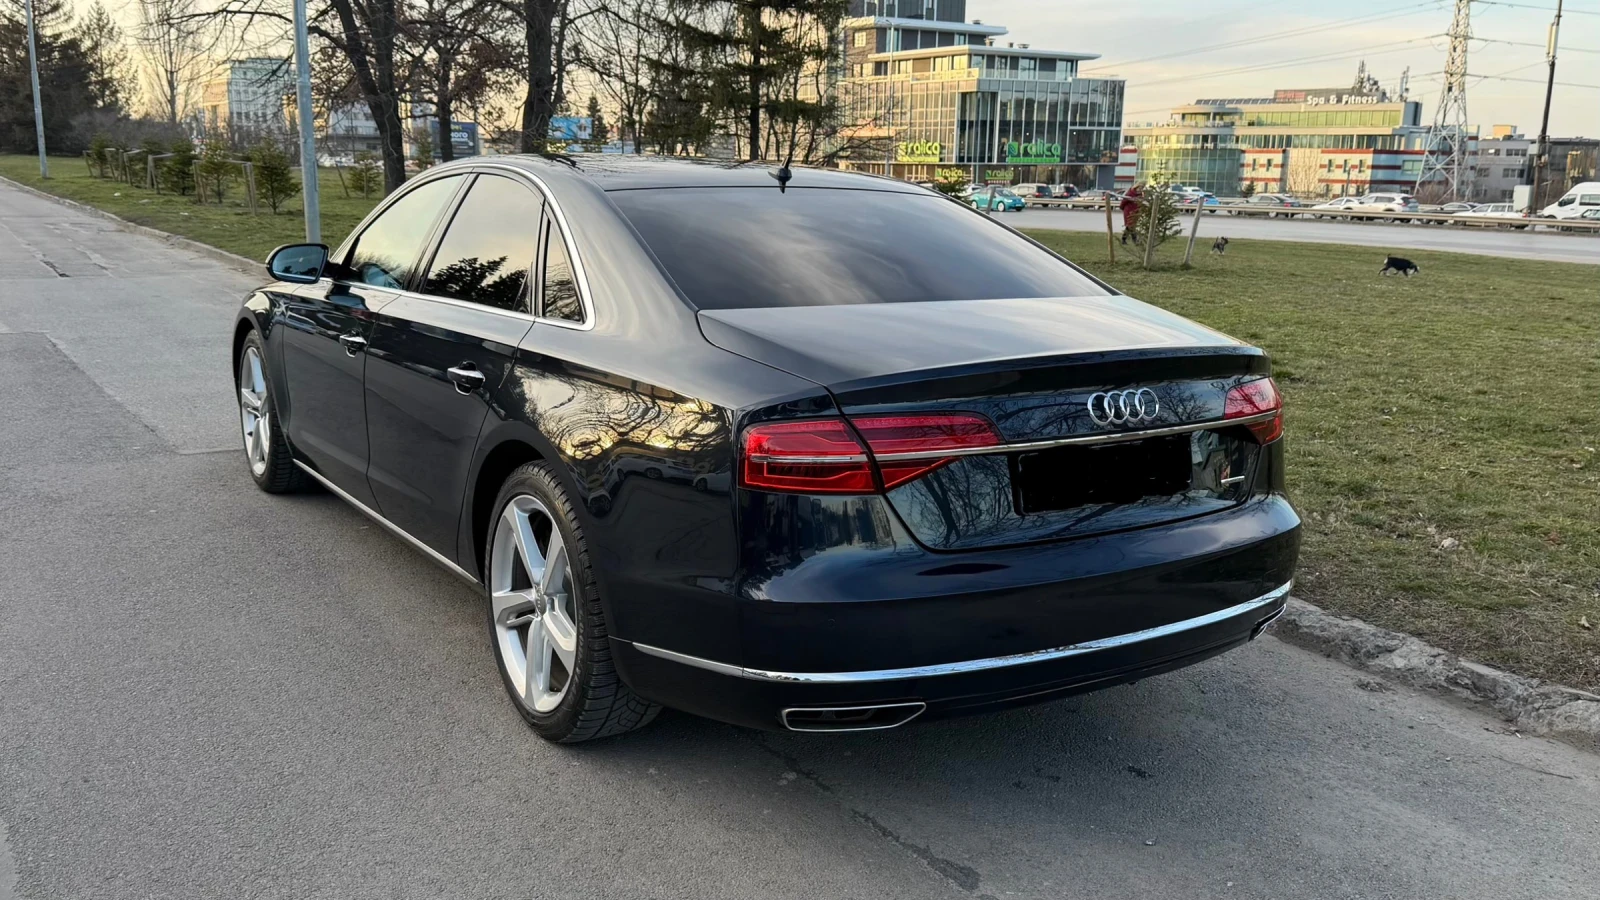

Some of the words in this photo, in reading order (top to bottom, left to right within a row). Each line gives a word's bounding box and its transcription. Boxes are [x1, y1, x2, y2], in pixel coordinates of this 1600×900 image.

[1307, 95, 1325, 106] Spa
[1329, 96, 1337, 104] &
[1342, 95, 1377, 105] Fitness
[907, 138, 940, 155] ralica
[1020, 138, 1061, 156] ralica
